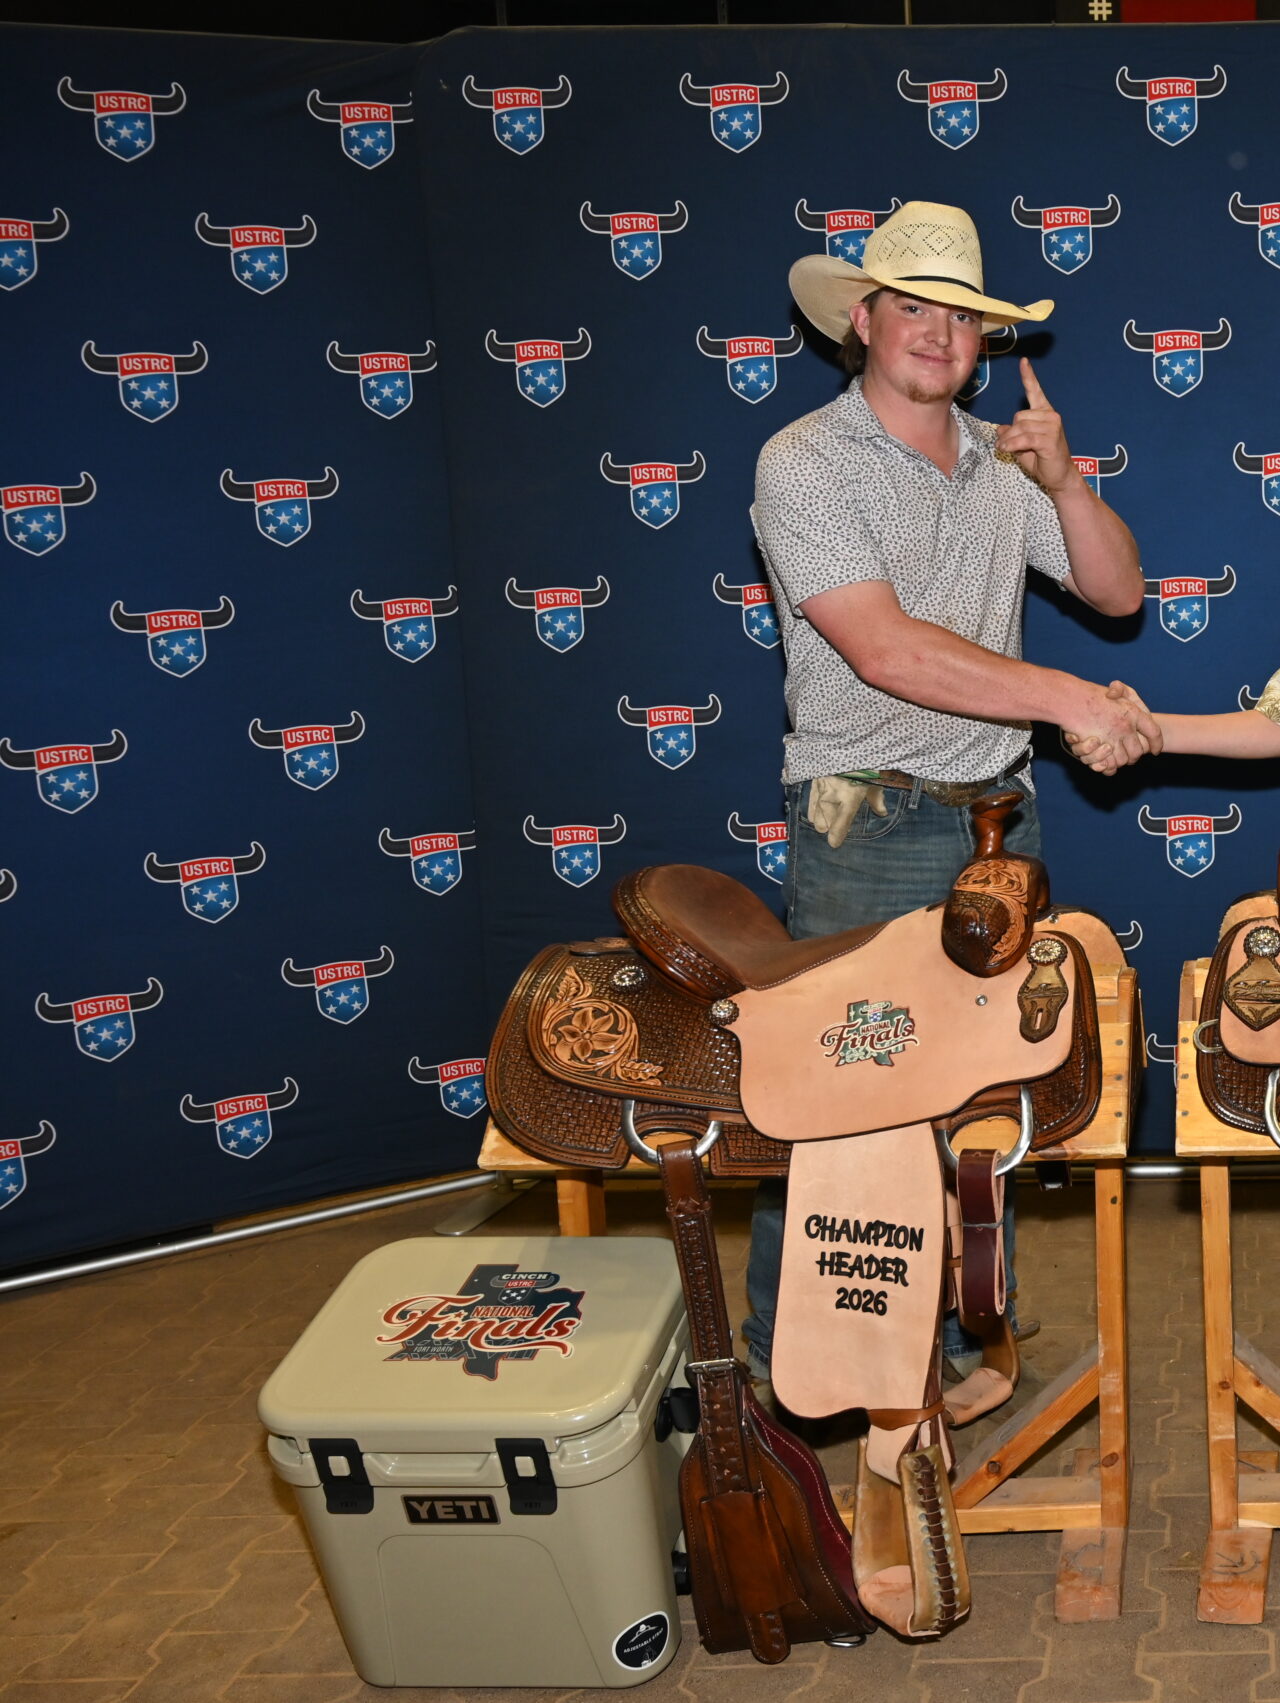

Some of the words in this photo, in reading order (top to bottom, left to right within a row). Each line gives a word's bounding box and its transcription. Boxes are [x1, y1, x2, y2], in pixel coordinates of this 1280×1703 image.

[714, 88, 755, 102] USTRC
[932, 85, 973, 99] USTRC
[1151, 81, 1192, 95] USTRC
[99, 95, 146, 110] USTRC
[497, 92, 538, 105] USTRC
[345, 106, 388, 119] USTRC
[614, 216, 655, 230] USTRC
[829, 214, 871, 227] USTRC
[1046, 211, 1087, 224] USTRC
[235, 230, 280, 243] USTRC
[730, 341, 771, 354] USTRC
[1157, 334, 1198, 348] USTRC
[519, 344, 559, 358] USTRC
[122, 357, 170, 371] USTRC
[363, 356, 406, 370] USTRC
[633, 467, 673, 480] USTRC
[7, 489, 57, 504] USTRC
[259, 483, 303, 497] USTRC
[746, 588, 771, 601] UST
[1164, 581, 1204, 594] USTRC
[538, 591, 578, 605] USTRC
[386, 601, 428, 616] USTRC
[151, 613, 198, 628] USTRC
[650, 709, 690, 723] USTRC
[287, 728, 330, 744] USTRC
[39, 748, 89, 764] USTRC
[1170, 819, 1210, 832] USTRC
[556, 829, 595, 842] USTRC
[414, 836, 455, 851] USTRC
[184, 860, 230, 877] USTRC
[318, 964, 361, 981] USTRC
[77, 998, 125, 1016] USTRC
[861, 1020, 890, 1034] NATIONAL
[820, 1015, 918, 1058] Finals
[442, 1061, 481, 1078] USTRC
[219, 1097, 263, 1116] USTRC
[804, 1214, 924, 1252] CHAMPION
[815, 1251, 909, 1287] HEADER
[835, 1287, 888, 1316] 2026
[472, 1305, 534, 1318] NATIONAL
[376, 1294, 581, 1356] Finals
[407, 1501, 490, 1520] YETI
